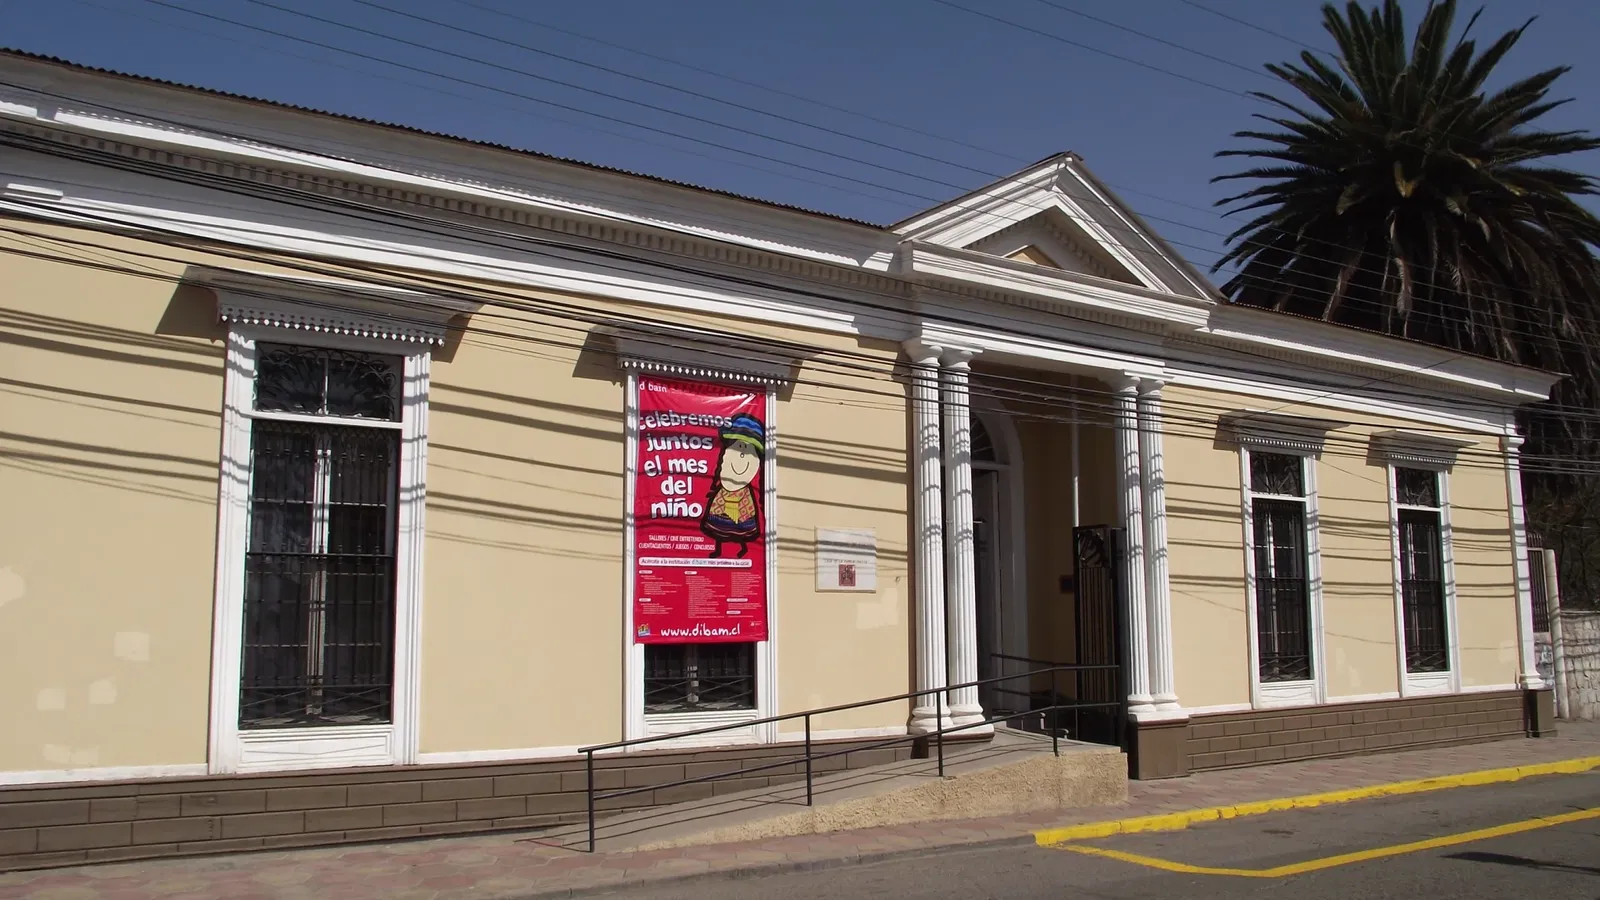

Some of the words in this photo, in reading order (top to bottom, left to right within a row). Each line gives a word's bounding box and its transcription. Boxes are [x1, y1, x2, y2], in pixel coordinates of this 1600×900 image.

[639, 410, 733, 430] celebremos
[647, 433, 713, 451] juntos
[644, 455, 662, 476] el
[668, 458, 708, 474] mes
[661, 476, 692, 495] del
[651, 498, 703, 518] niño
[661, 623, 740, 636] www.dibam.cl
